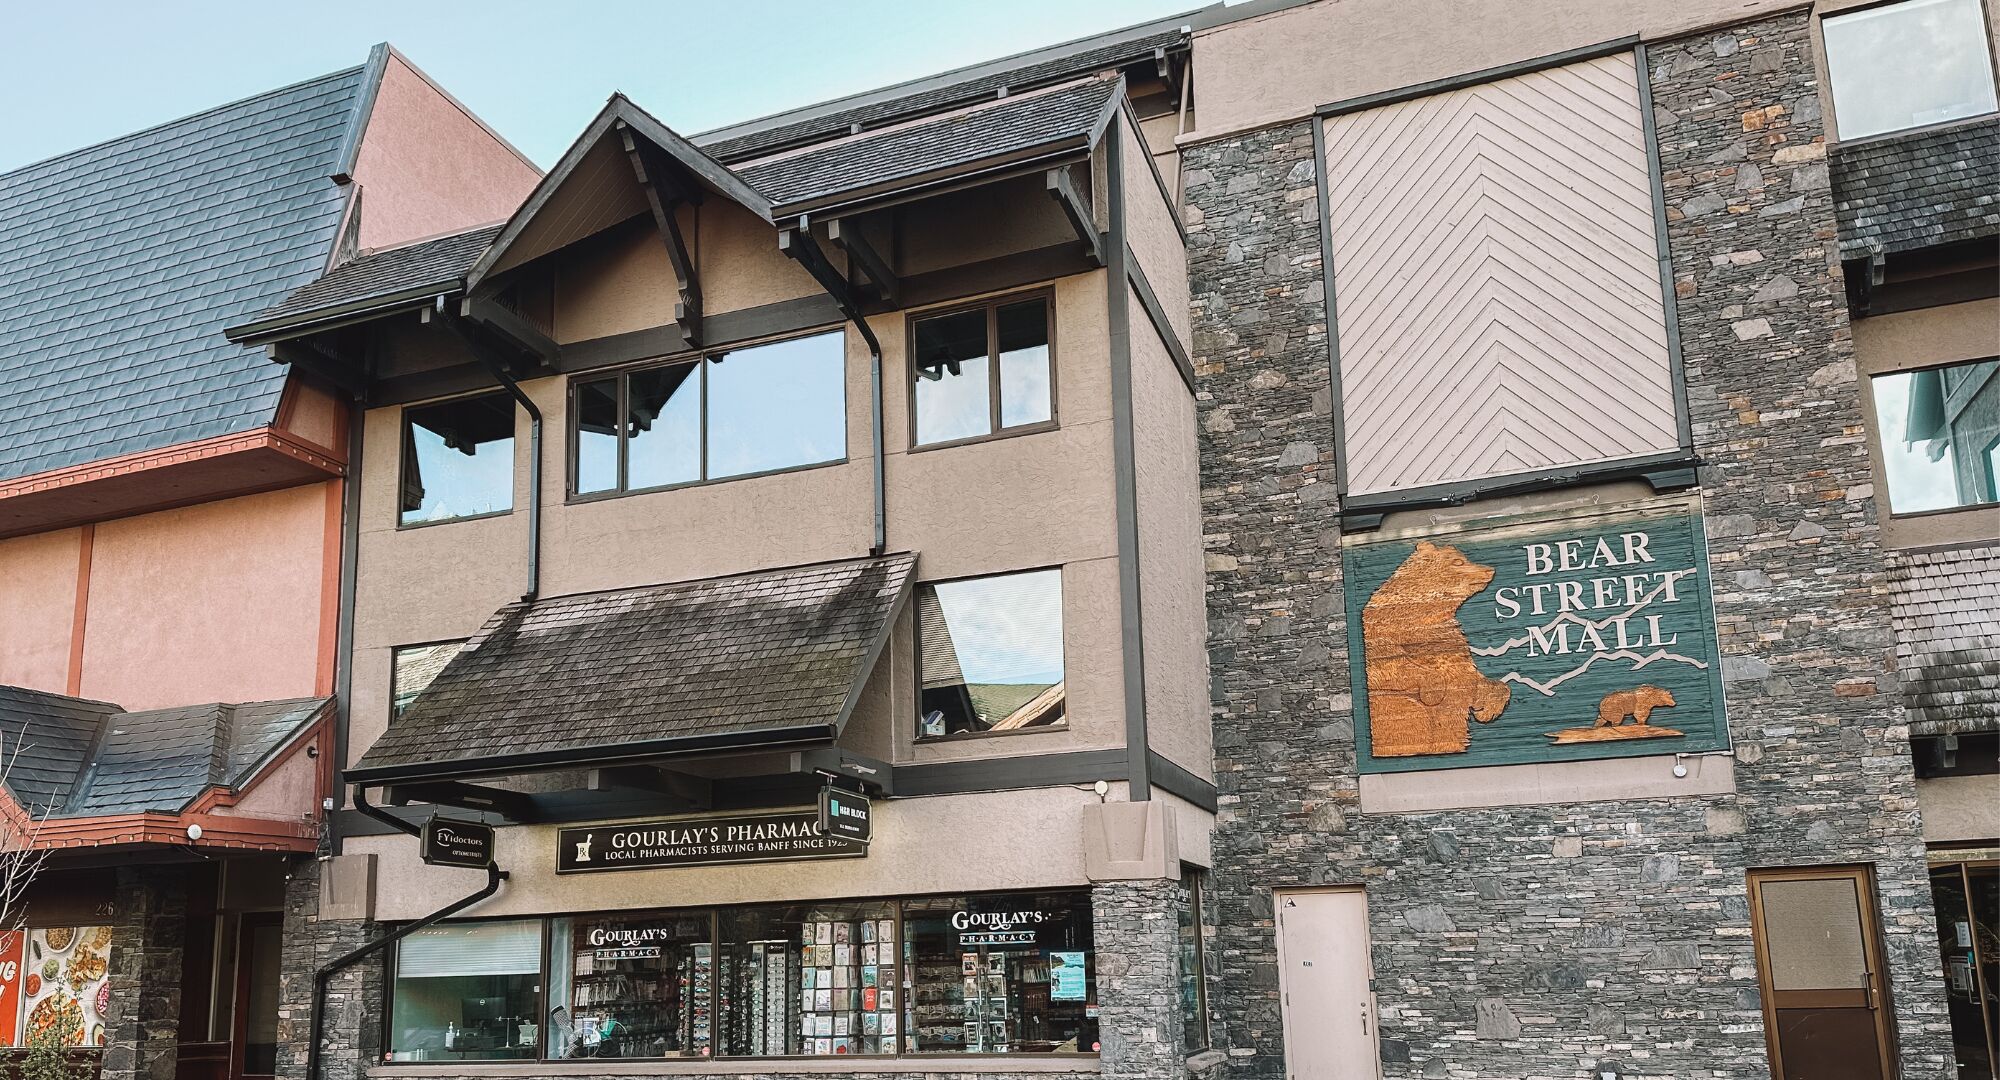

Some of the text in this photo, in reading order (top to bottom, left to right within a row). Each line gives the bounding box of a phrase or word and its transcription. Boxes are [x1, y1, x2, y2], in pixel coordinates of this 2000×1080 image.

[1522, 531, 1656, 576] BEAR
[1494, 570, 1684, 619] STREET
[1524, 614, 1678, 657] MALL
[839, 805, 867, 820] H&R BLOCK
[611, 820, 822, 849] GOURLAY'S PHARMAC
[605, 850, 637, 860] LOCAL
[640, 845, 708, 858] PHARMACISTS
[710, 843, 754, 854] SERVING
[758, 841, 790, 851] BANFF
[793, 839, 824, 849] SINCE
[95, 901, 114, 916] 226
[951, 911, 1043, 930] GOURLAY'S
[590, 928, 668, 946] GOURLAY'S
